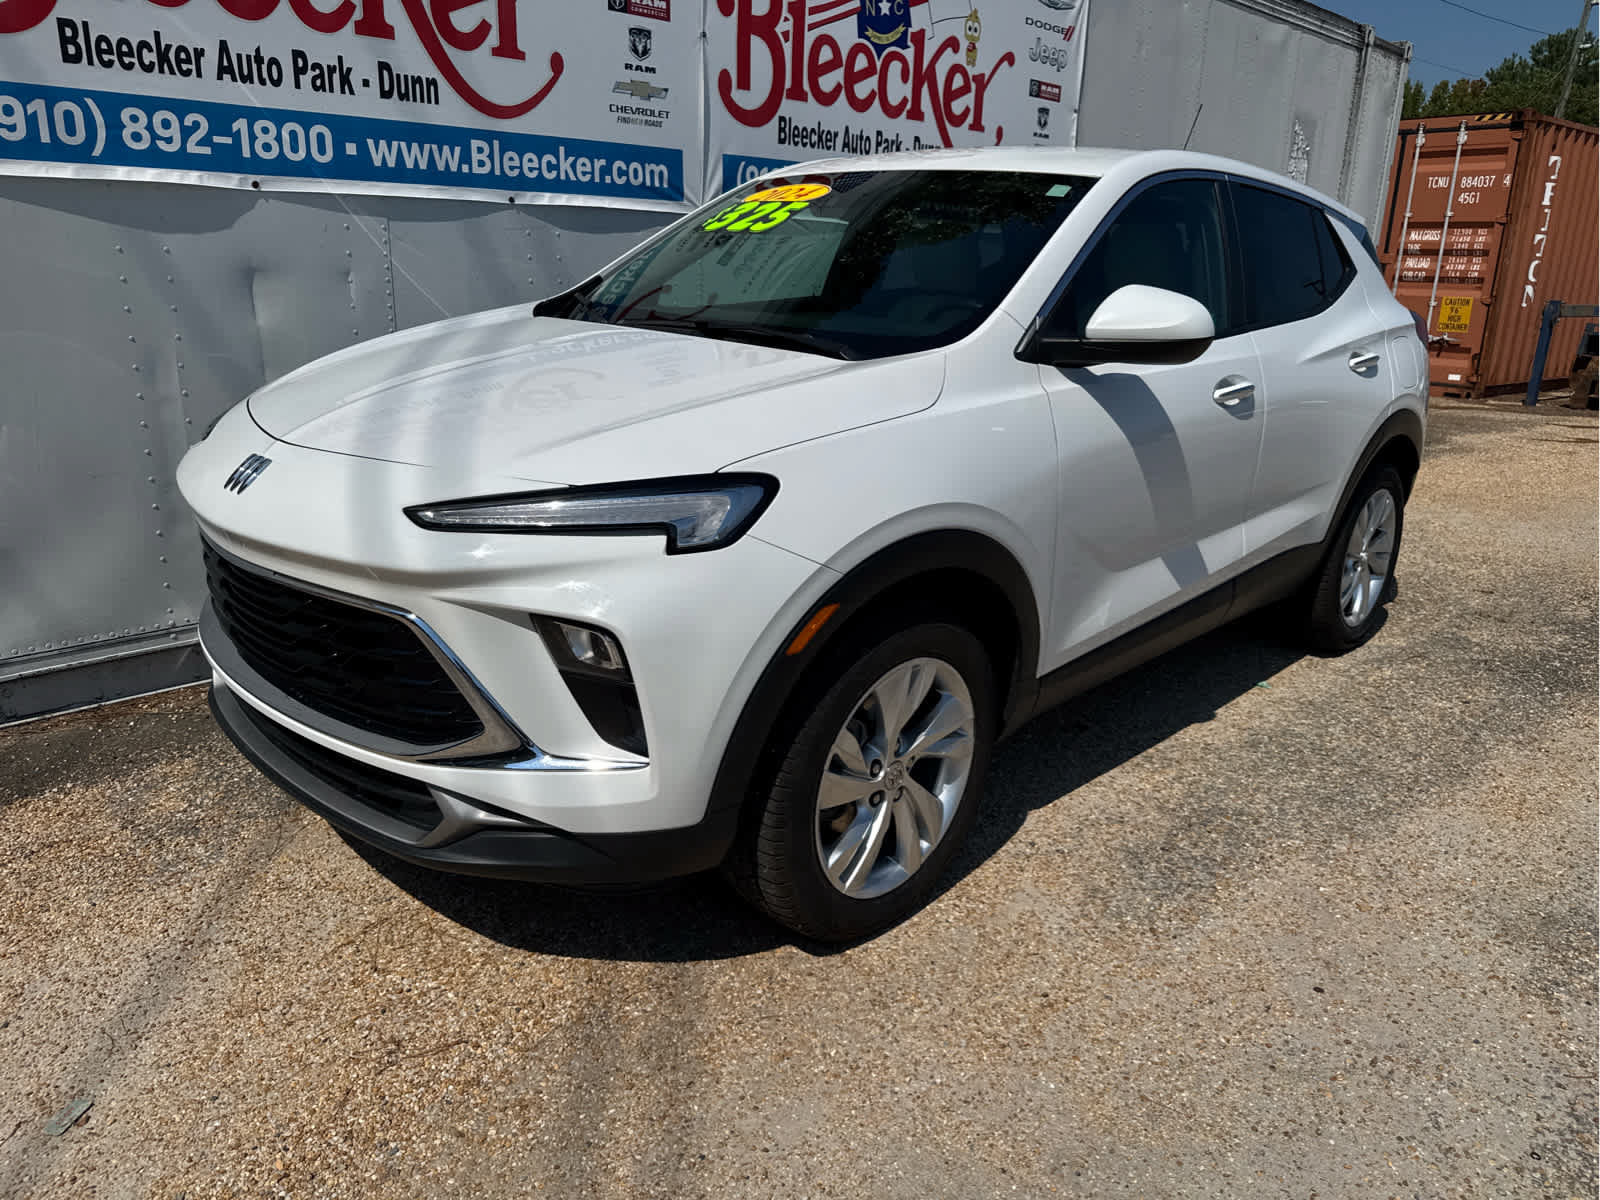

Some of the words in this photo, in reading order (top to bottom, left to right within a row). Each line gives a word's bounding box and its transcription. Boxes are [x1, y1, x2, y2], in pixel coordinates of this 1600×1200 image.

[865, 0, 876, 16] N
[894, 0, 905, 15] C
[1025, 17, 1068, 35] DODGE
[56, 17, 205, 79] Bleecker
[216, 39, 284, 88] Auto
[291, 49, 356, 96] Park
[377, 60, 440, 105] Dunn
[1029, 37, 1068, 72] Jeep
[624, 62, 657, 74] RAM
[718, 0, 1016, 148] Bleecker
[609, 104, 671, 119] CHEVROLET
[777, 115, 839, 152] Bleecker
[842, 126, 872, 156] Auto
[875, 131, 904, 154] Park
[120, 106, 334, 164] 892-1800
[366, 138, 670, 189] www.Bleecker.com
[1428, 176, 1450, 189] TCNU
[1460, 175, 1496, 189] 884037
[1503, 174, 1512, 187] 4
[1457, 192, 1480, 205] 45G1
[1444, 298, 1470, 306] CAUTION
